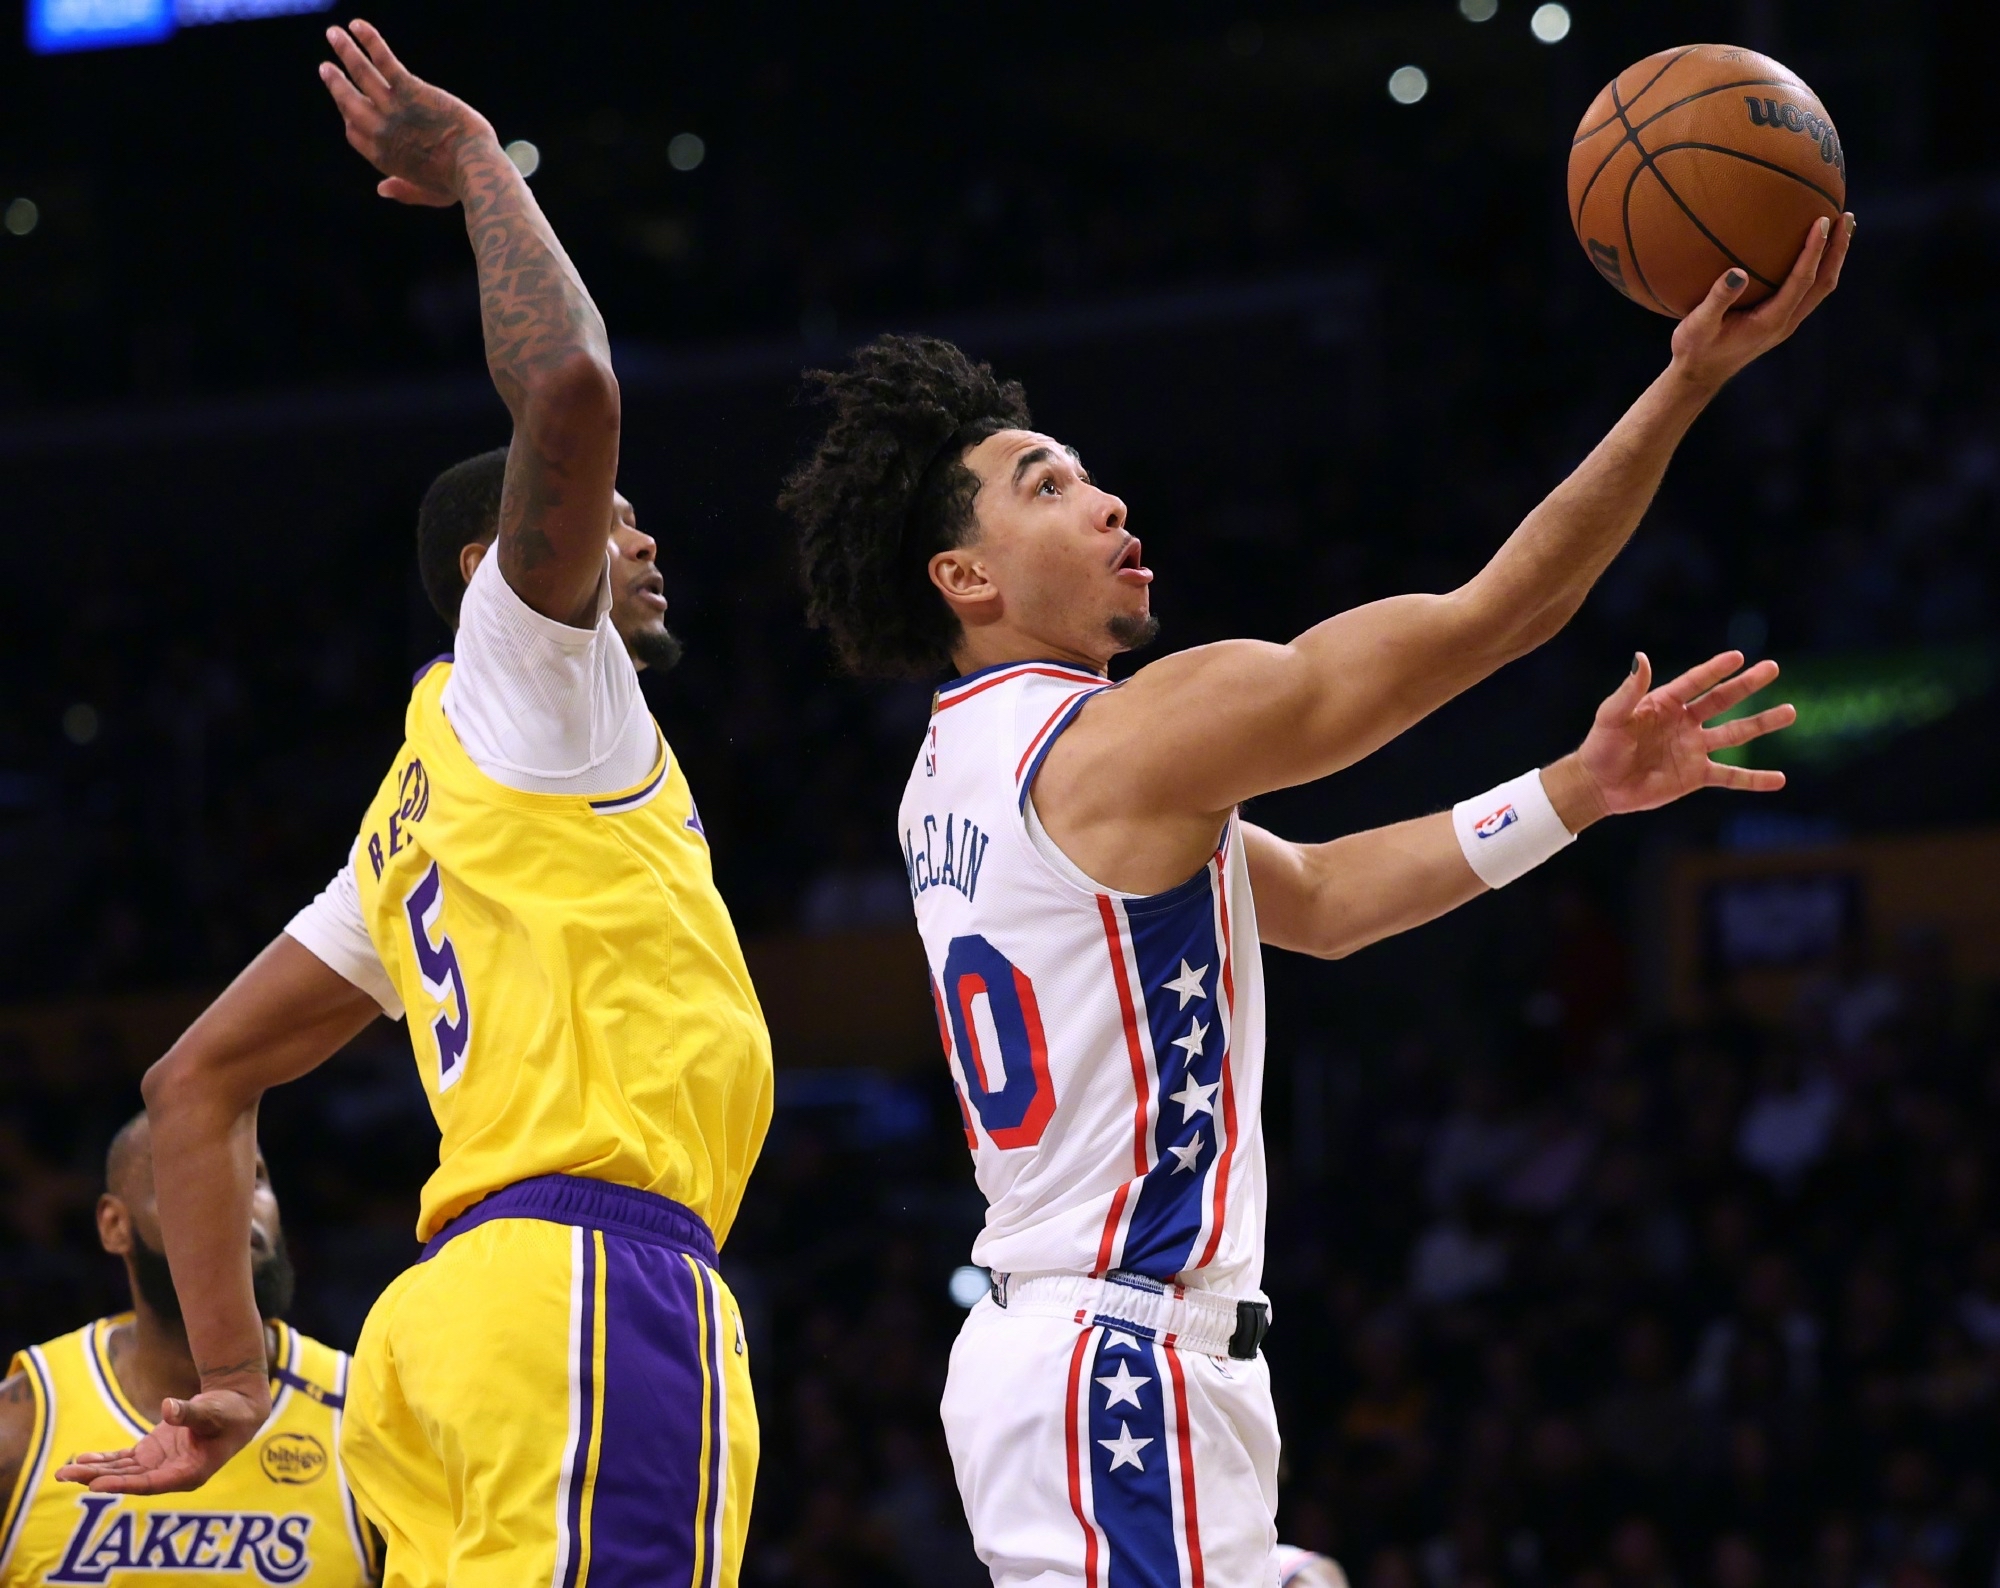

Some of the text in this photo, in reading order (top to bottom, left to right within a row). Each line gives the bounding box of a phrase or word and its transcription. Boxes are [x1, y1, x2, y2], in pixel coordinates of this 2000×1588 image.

[403, 860, 471, 1094] 5
[929, 934, 1057, 1151] 0
[46, 1496, 312, 1585] LAKERS
